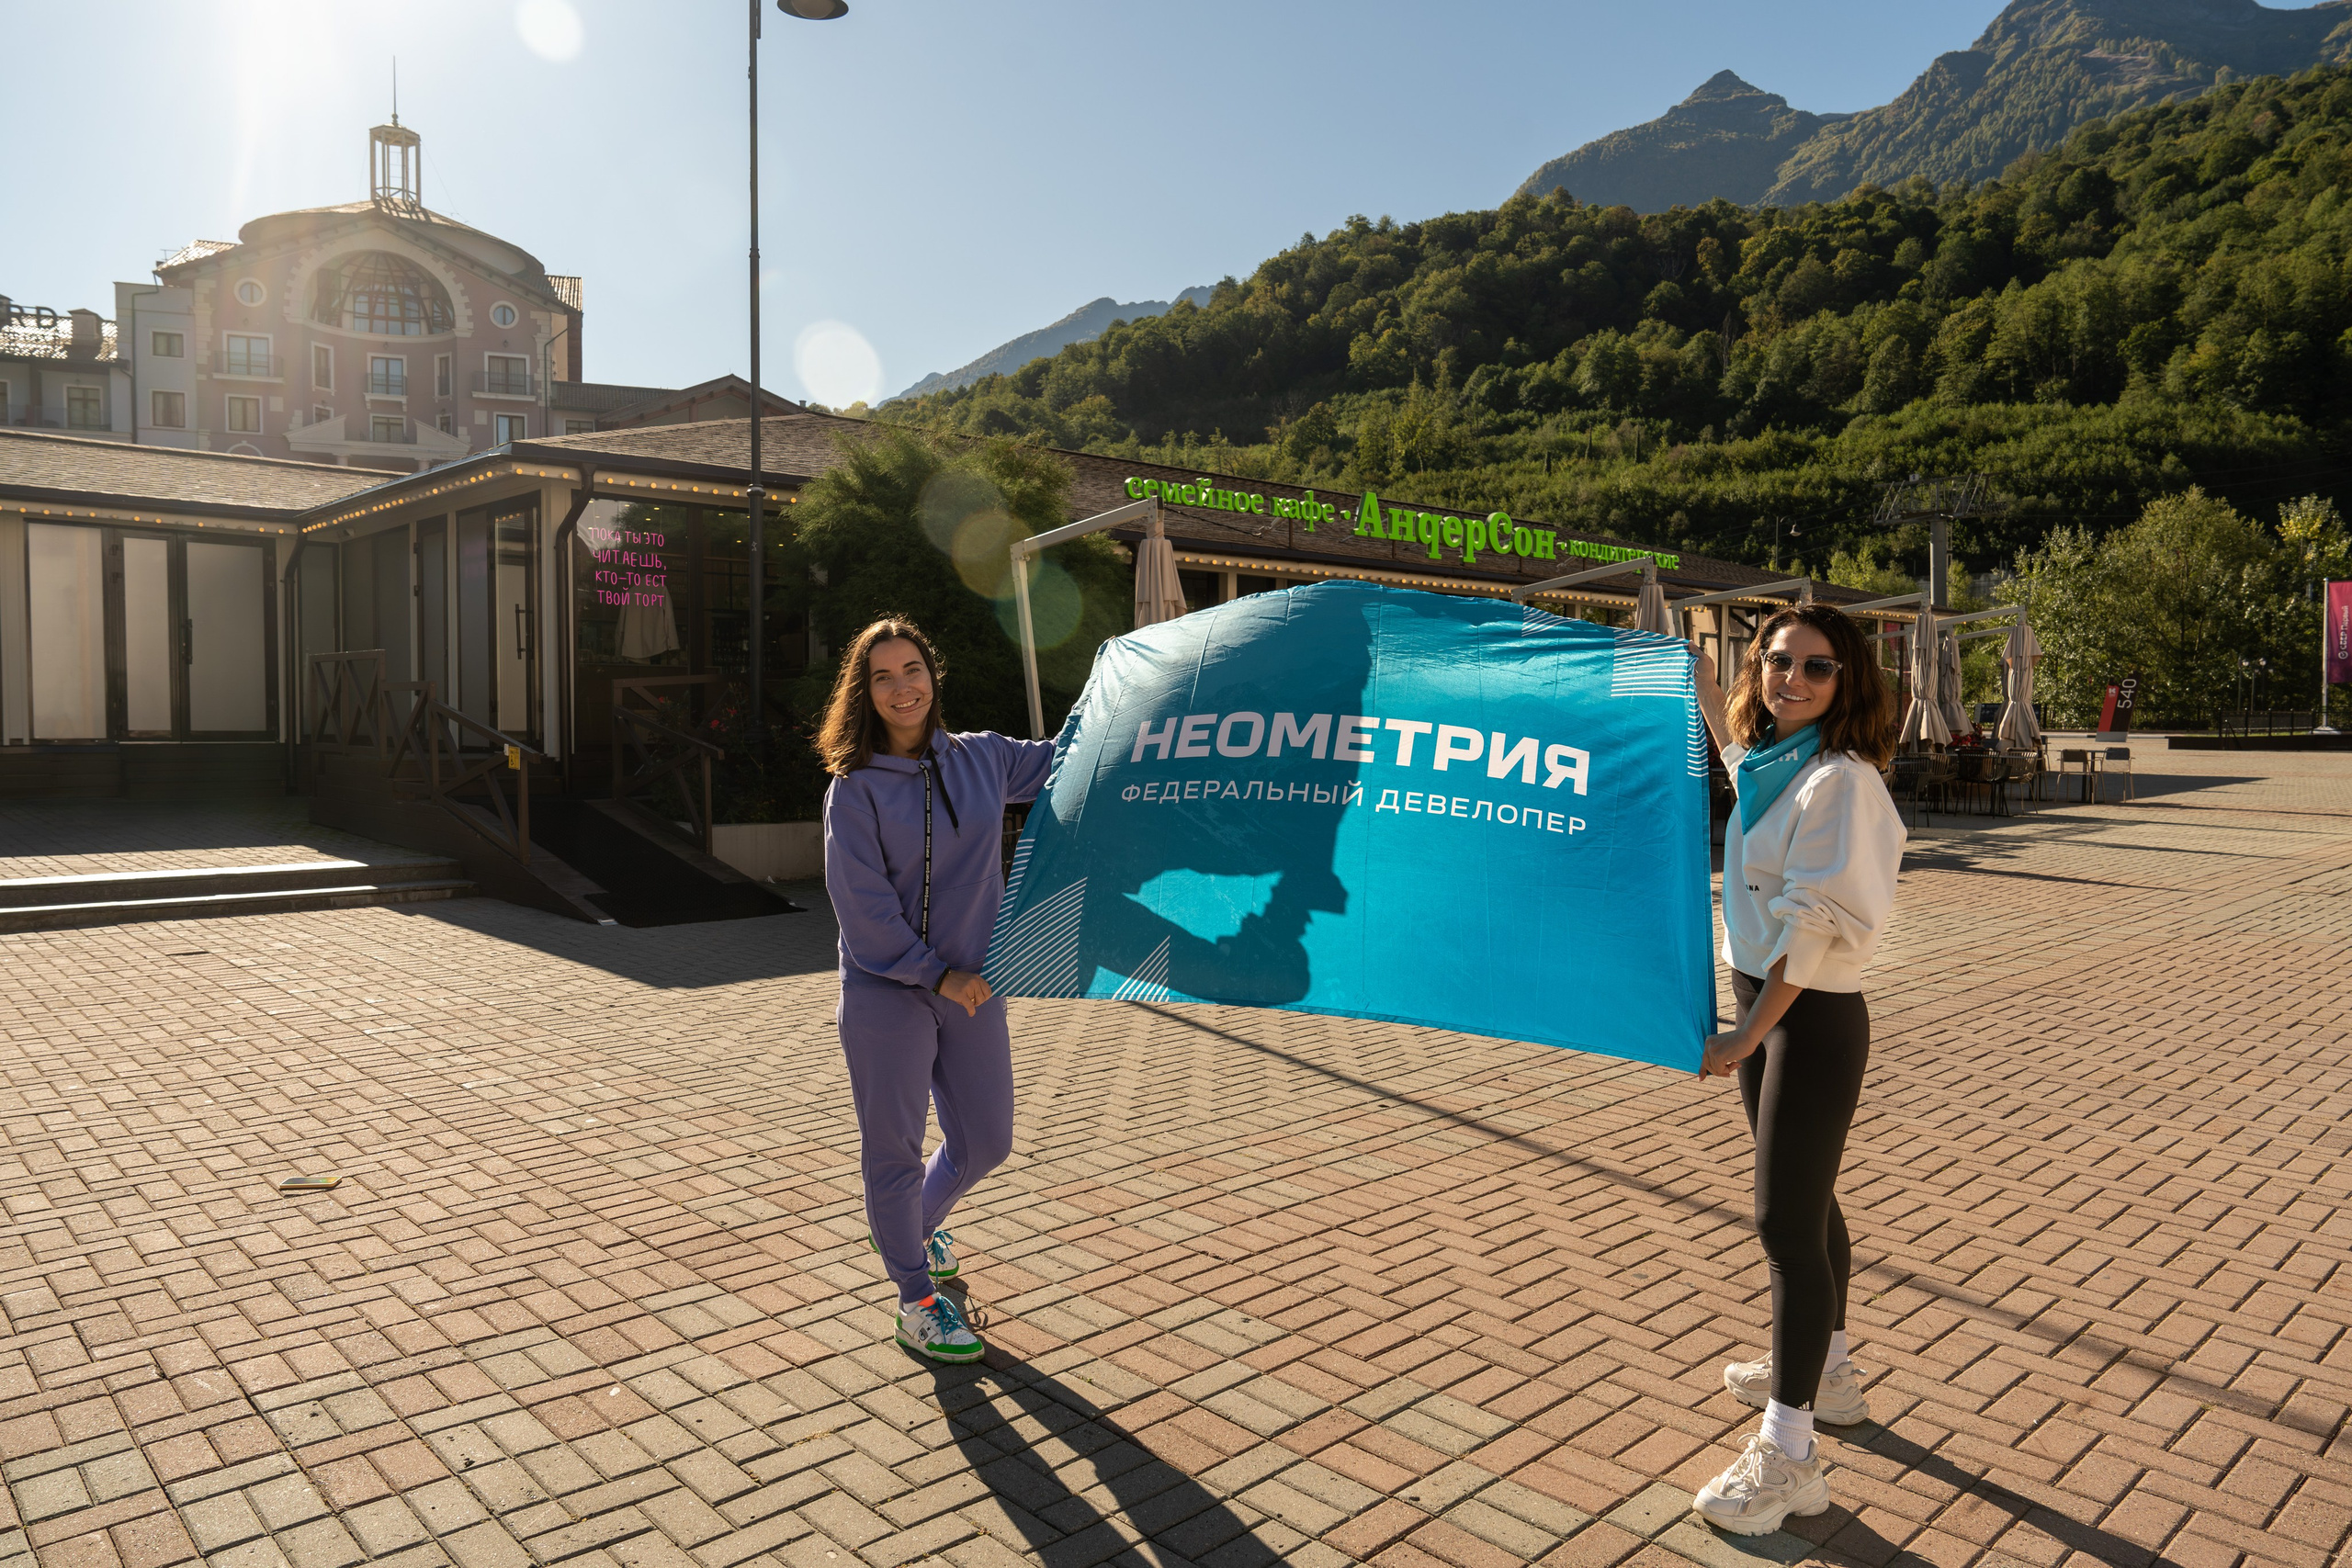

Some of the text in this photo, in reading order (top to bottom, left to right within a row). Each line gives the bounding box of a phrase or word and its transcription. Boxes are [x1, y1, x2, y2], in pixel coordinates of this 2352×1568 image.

[1124, 477, 1264, 514] семейное
[1270, 490, 1335, 532] кафе
[590, 527, 664, 547] ПОКА ТЫ ЭТО
[593, 549, 667, 570] ЧИТАЕШЬ,
[645, 574, 667, 587] ЕСТ
[597, 586, 665, 607] ТВОЙ ТОРТ
[2117, 679, 2137, 709] 540
[1130, 711, 1589, 796] НЕОМЕТРИЯ
[1121, 779, 1586, 835] ФЕДЕРАЛЬНЫЙ ДЕВЕЛОПЕР
